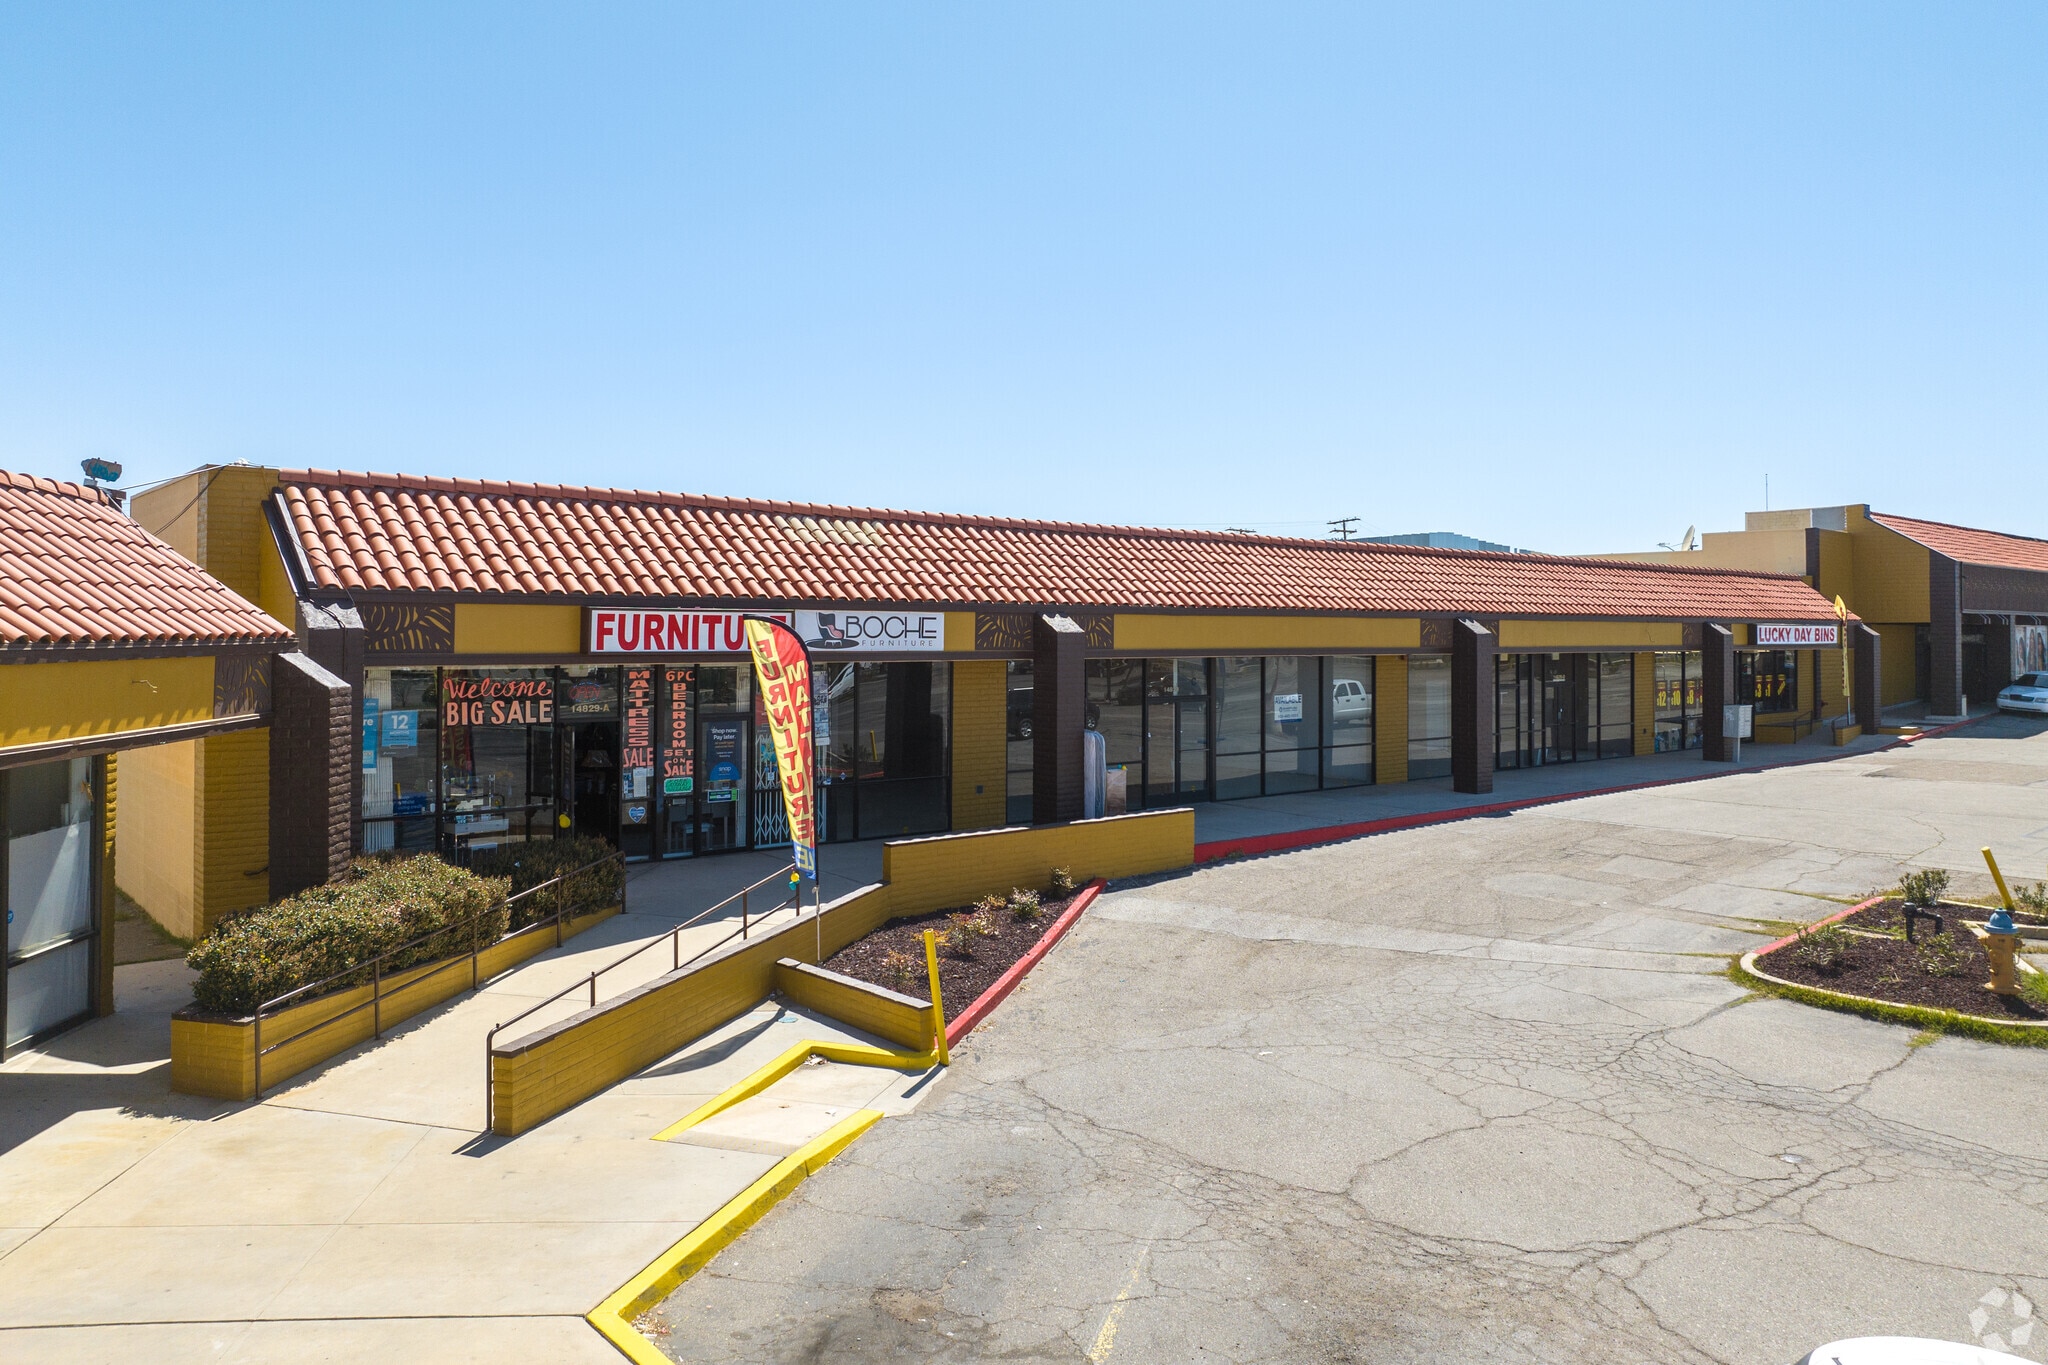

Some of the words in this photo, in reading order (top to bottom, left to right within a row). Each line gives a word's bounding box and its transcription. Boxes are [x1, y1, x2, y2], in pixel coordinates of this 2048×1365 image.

[596, 613, 786, 651] FURNITU
[845, 616, 937, 639] BOCHE
[1759, 627, 1792, 642] LUCKY
[1794, 627, 1812, 642] DAY
[1814, 627, 1835, 642] BINS
[861, 639, 934, 647] FURNITURE
[443, 677, 553, 699] Welcome
[569, 685, 601, 699] OPEN
[1275, 695, 1302, 704] AVAILABLE
[1656, 690, 1667, 707] $12
[1671, 690, 1681, 706] $10
[1686, 689, 1694, 705] $8
[446, 701, 485, 726] BIG
[491, 700, 553, 725] SALE
[571, 703, 610, 713] 14829-A
[628, 670, 650, 747] MATTRESS
[672, 682, 687, 748] BEDROOM
[391, 714, 409, 729] 12
[622, 747, 654, 768] SALE
[663, 749, 694, 757] SET
[664, 760, 694, 778] SALE
